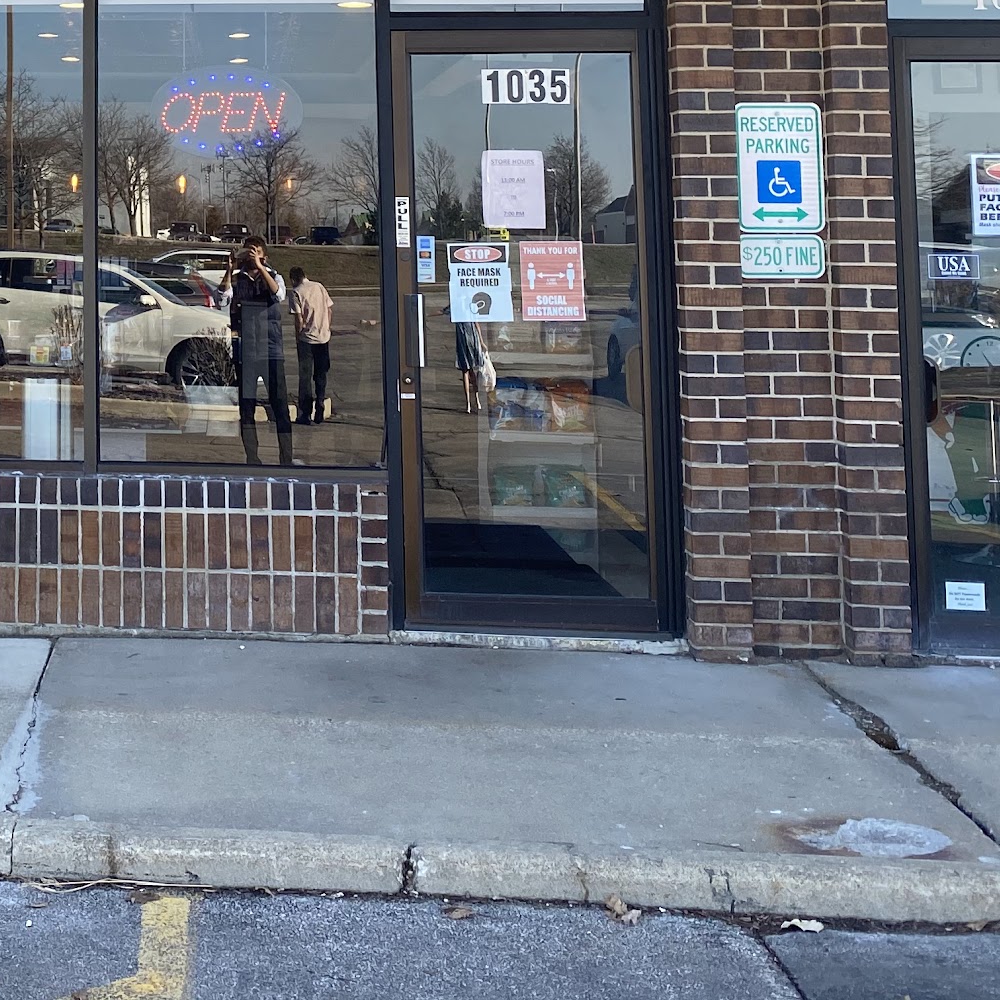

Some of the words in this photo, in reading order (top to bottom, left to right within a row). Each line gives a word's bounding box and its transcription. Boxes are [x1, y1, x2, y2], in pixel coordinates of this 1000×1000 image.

[486, 69, 568, 103] 1035
[161, 91, 286, 133] OPEN
[740, 116, 814, 132] RESERVED
[746, 138, 810, 154] PARKING
[397, 201, 408, 229] PULL
[464, 249, 491, 260] STOP
[523, 247, 546, 255] THANK
[548, 247, 563, 255] YOU
[564, 247, 578, 255] FOR
[742, 246, 782, 266] $250
[786, 246, 818, 266] FINE
[937, 256, 971, 271] USA
[457, 268, 476, 276] FACE
[477, 268, 501, 276] MASK
[460, 278, 499, 288] REQUIRED
[536, 295, 568, 305] SOCIAL
[527, 306, 580, 316] DISTANCING
